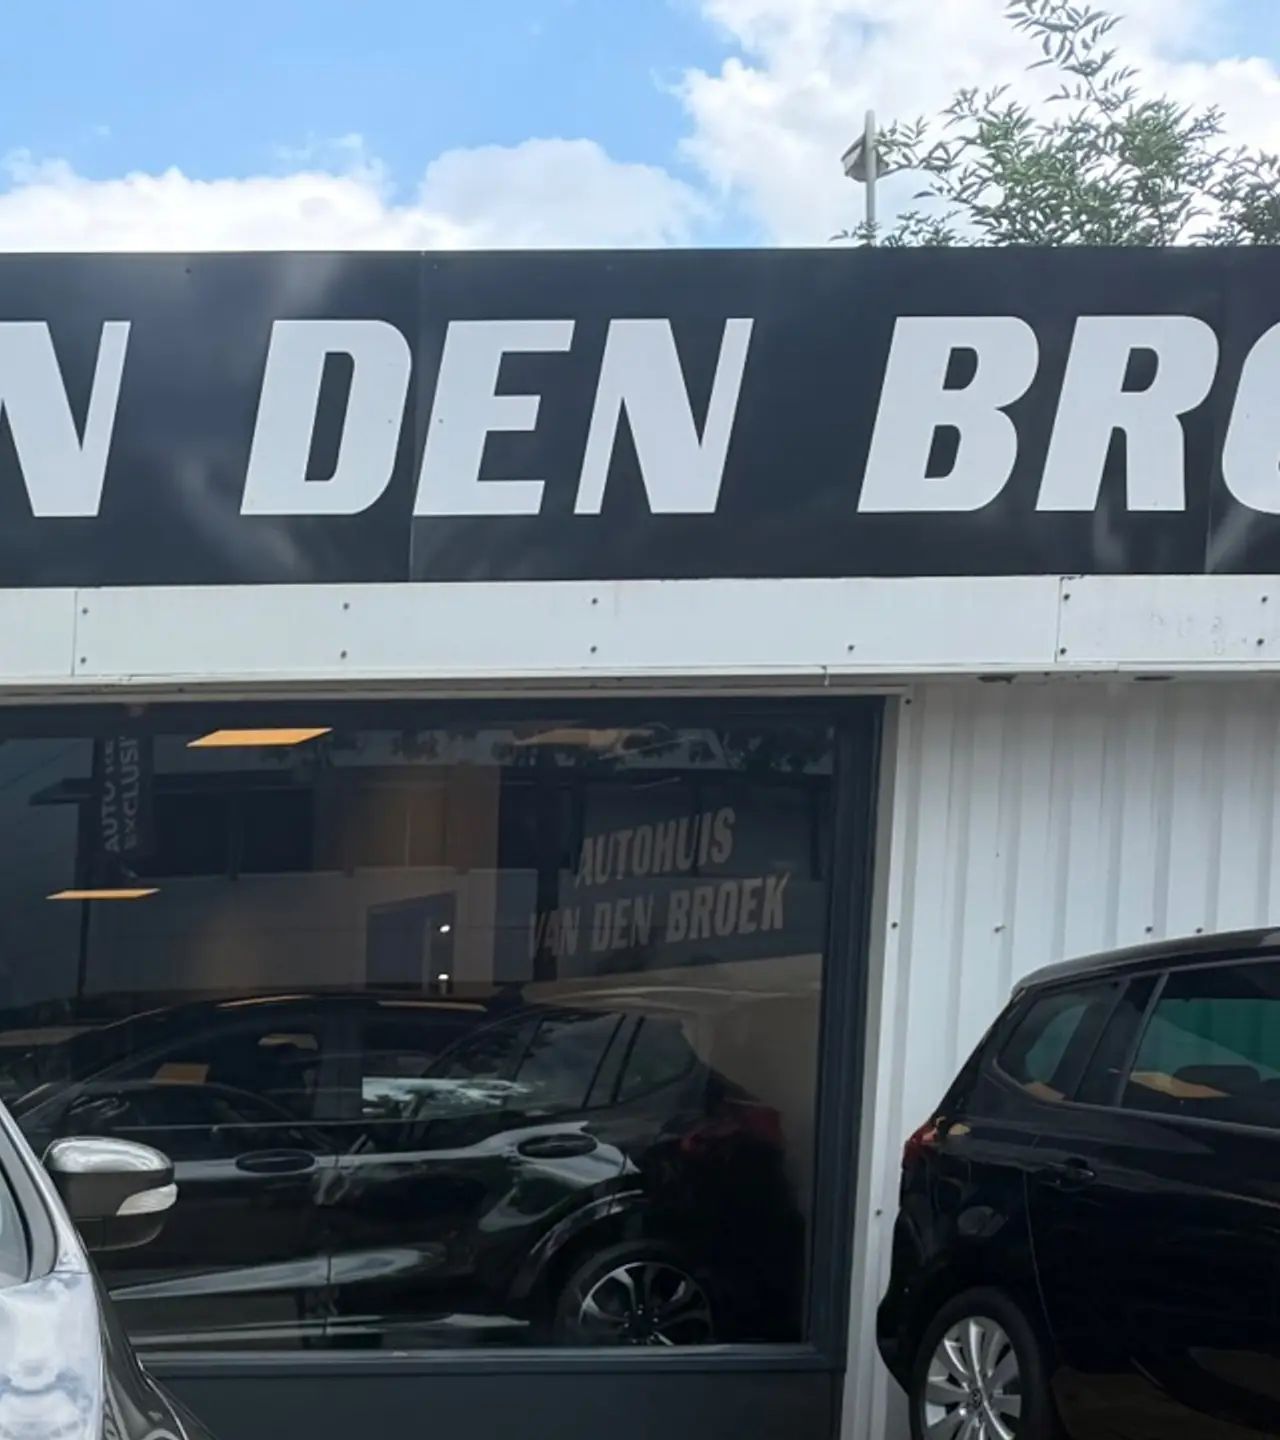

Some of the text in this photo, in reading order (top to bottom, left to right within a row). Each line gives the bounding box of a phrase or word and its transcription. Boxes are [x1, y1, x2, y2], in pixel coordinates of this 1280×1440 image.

[238, 318, 755, 516] DEN
[575, 806, 737, 890] AUTOHUIS
[528, 871, 792, 960] VAN DEN BROEK
